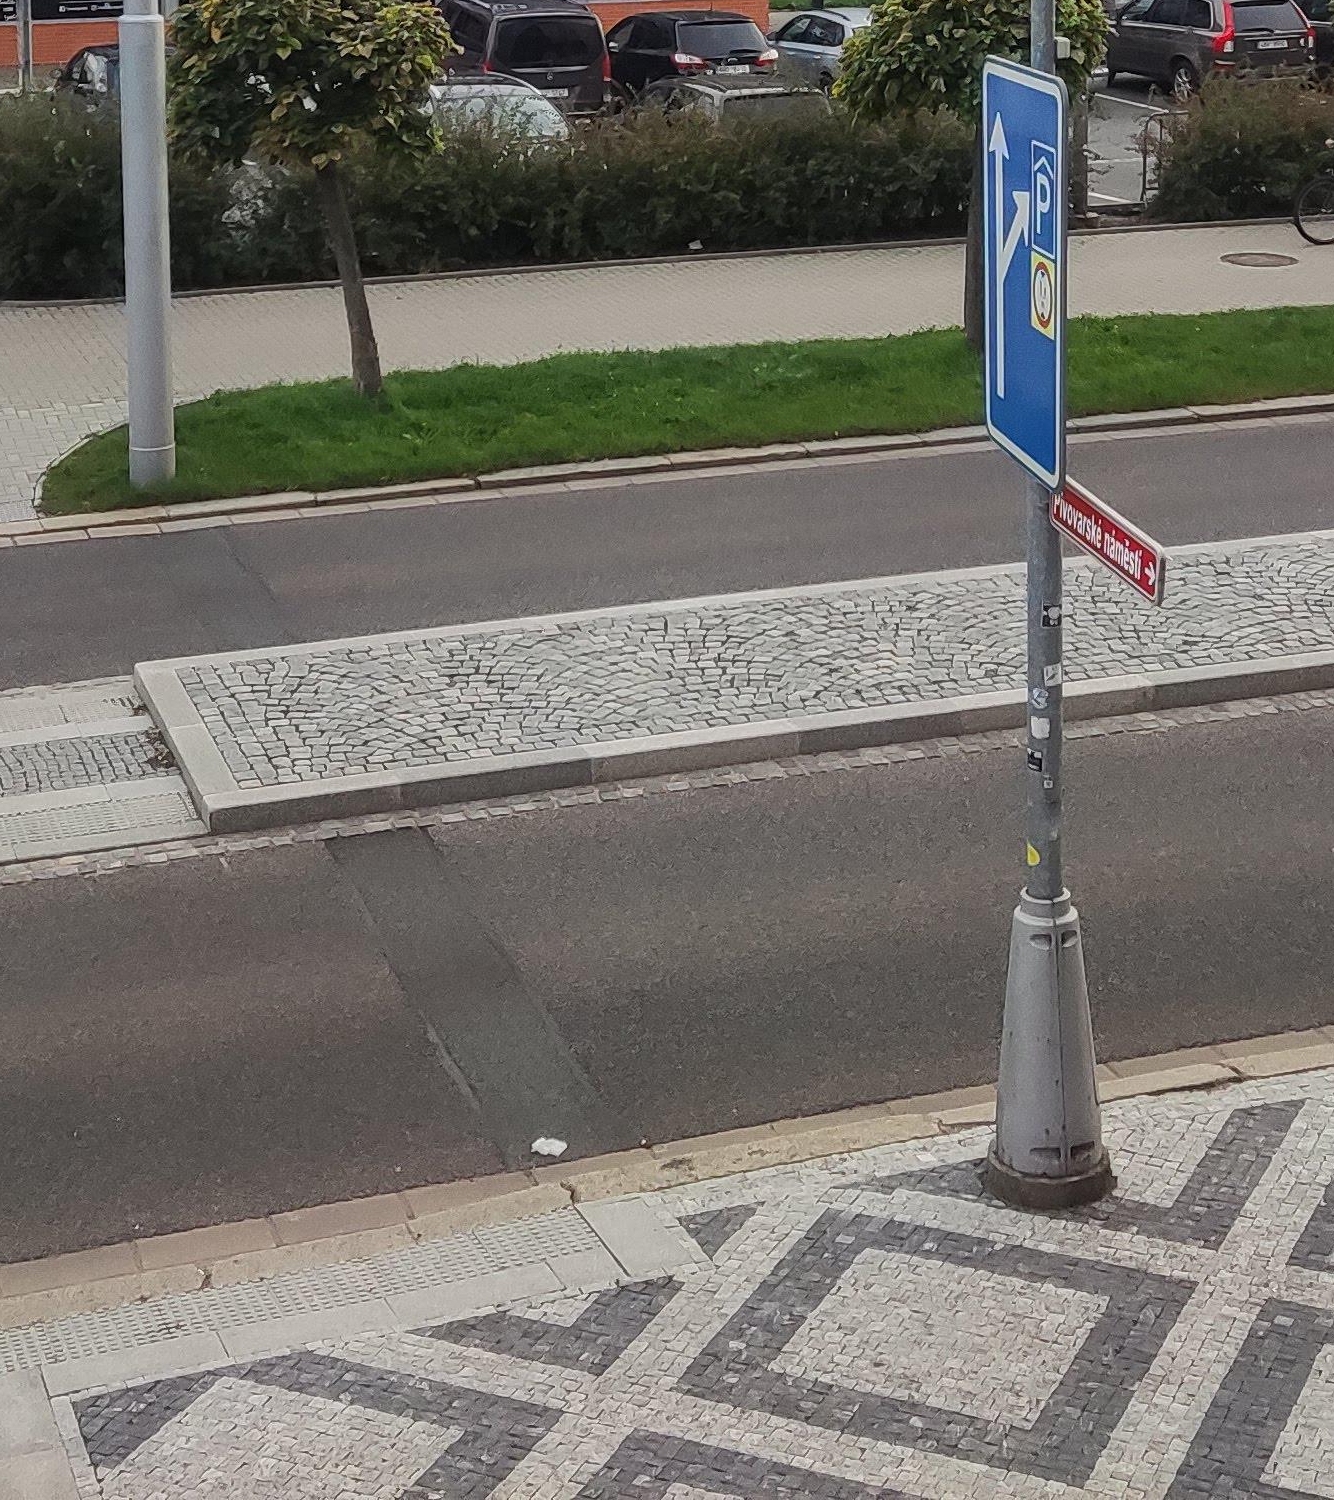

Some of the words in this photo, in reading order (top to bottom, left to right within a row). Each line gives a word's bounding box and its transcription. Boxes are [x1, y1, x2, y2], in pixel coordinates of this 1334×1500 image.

[1036, 171, 1052, 235] P
[1053, 491, 1102, 550] Pivovarské
[1103, 529, 1143, 581] náměstí
